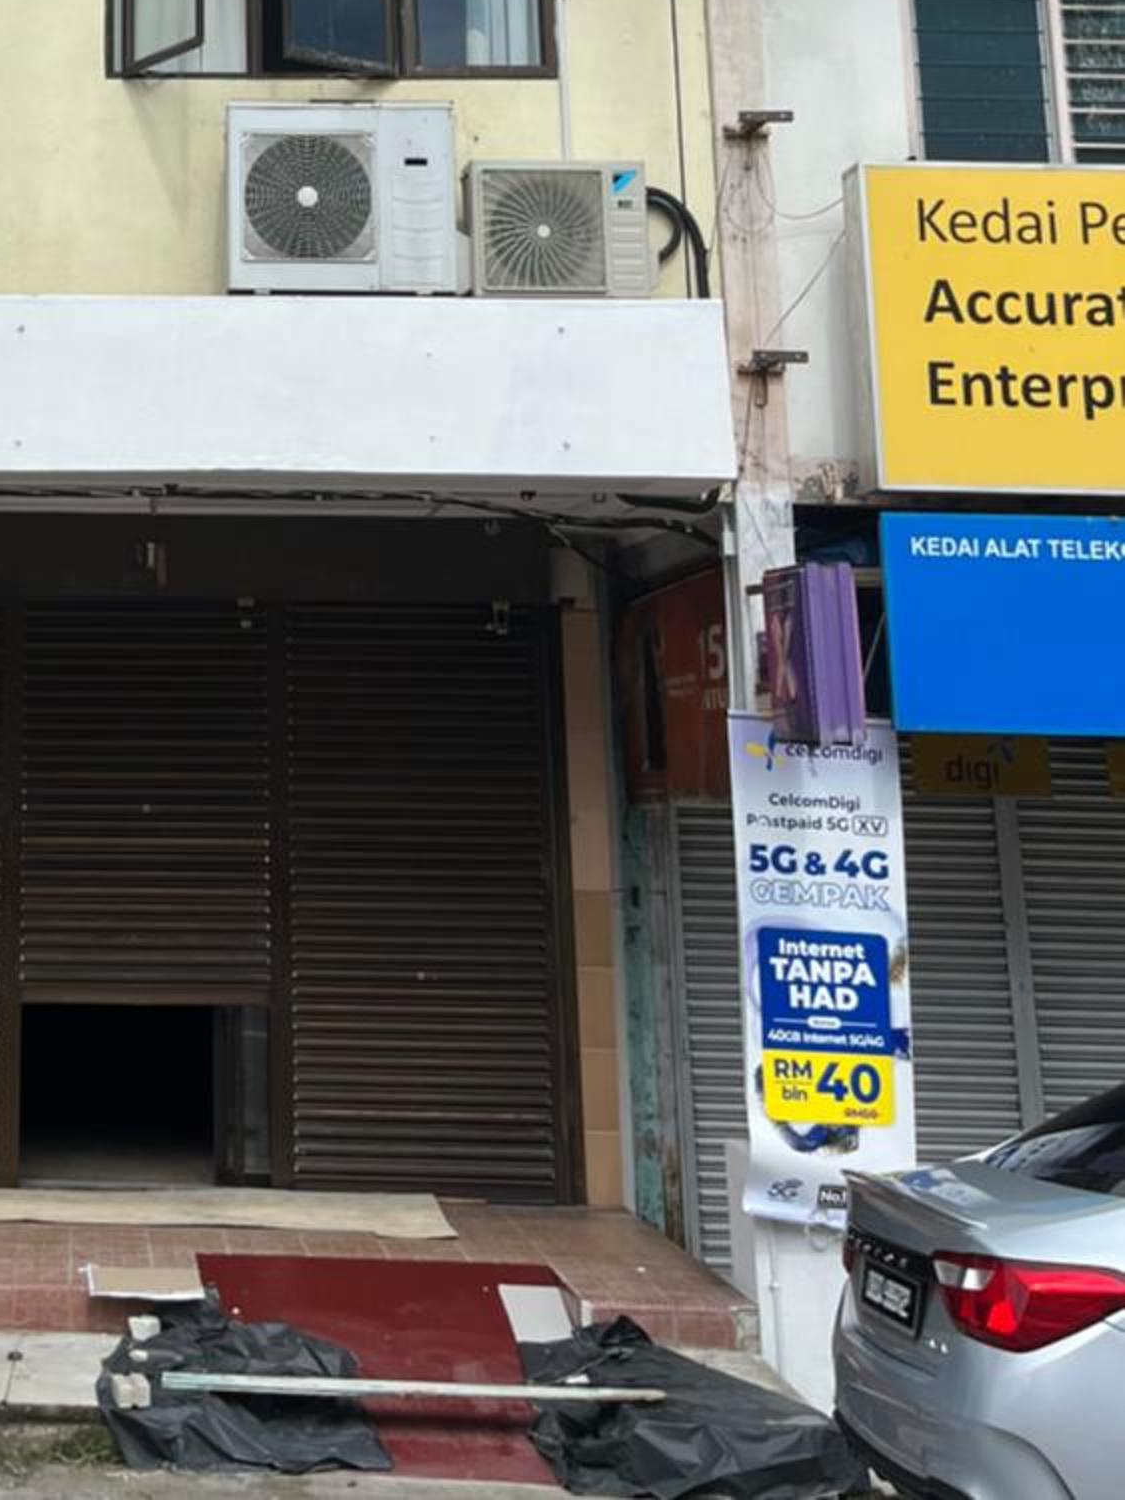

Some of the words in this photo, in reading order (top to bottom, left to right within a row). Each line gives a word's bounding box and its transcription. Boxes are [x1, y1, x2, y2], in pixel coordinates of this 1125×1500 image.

[916, 197, 1058, 245] Kedai
[927, 361, 1125, 420] Enterp
[910, 536, 980, 558] KEDAI
[984, 538, 1041, 559] ALAT
[785, 744, 884, 764] cecomdigi
[945, 755, 999, 787] digi
[768, 792, 860, 812] CelcomDigi
[827, 817, 850, 832] 5G
[749, 844, 797, 874] 5G
[804, 852, 826, 876] &
[834, 850, 890, 880] 4G
[750, 879, 891, 911] GEMPAK
[779, 938, 865, 959] Internet
[769, 957, 876, 987] TANPA
[789, 984, 858, 1012] HAD
[774, 1058, 812, 1080] RM
[816, 1062, 881, 1103] 40
[782, 1085, 808, 1102] bln
